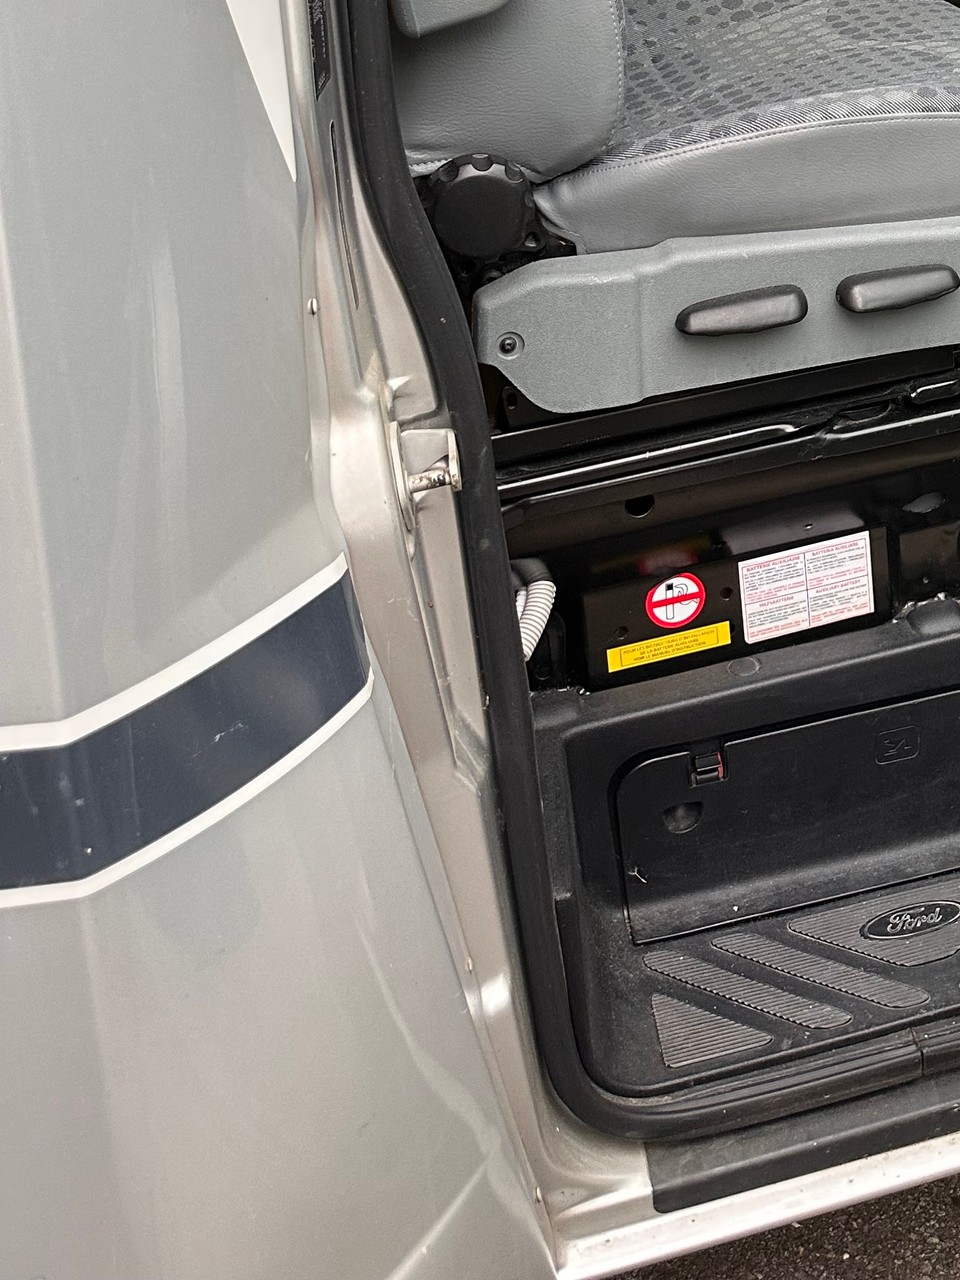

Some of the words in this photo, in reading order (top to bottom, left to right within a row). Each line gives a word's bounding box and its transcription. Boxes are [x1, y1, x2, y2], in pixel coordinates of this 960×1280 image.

[746, 563, 770, 572] BATTERIE
[815, 584, 840, 594] AUXILIARY
[840, 579, 861, 588] BATTERY
[654, 644, 674, 653] BATTERIE
[651, 650, 670, 658] MANUEL
[886, 907, 943, 934] Ford
